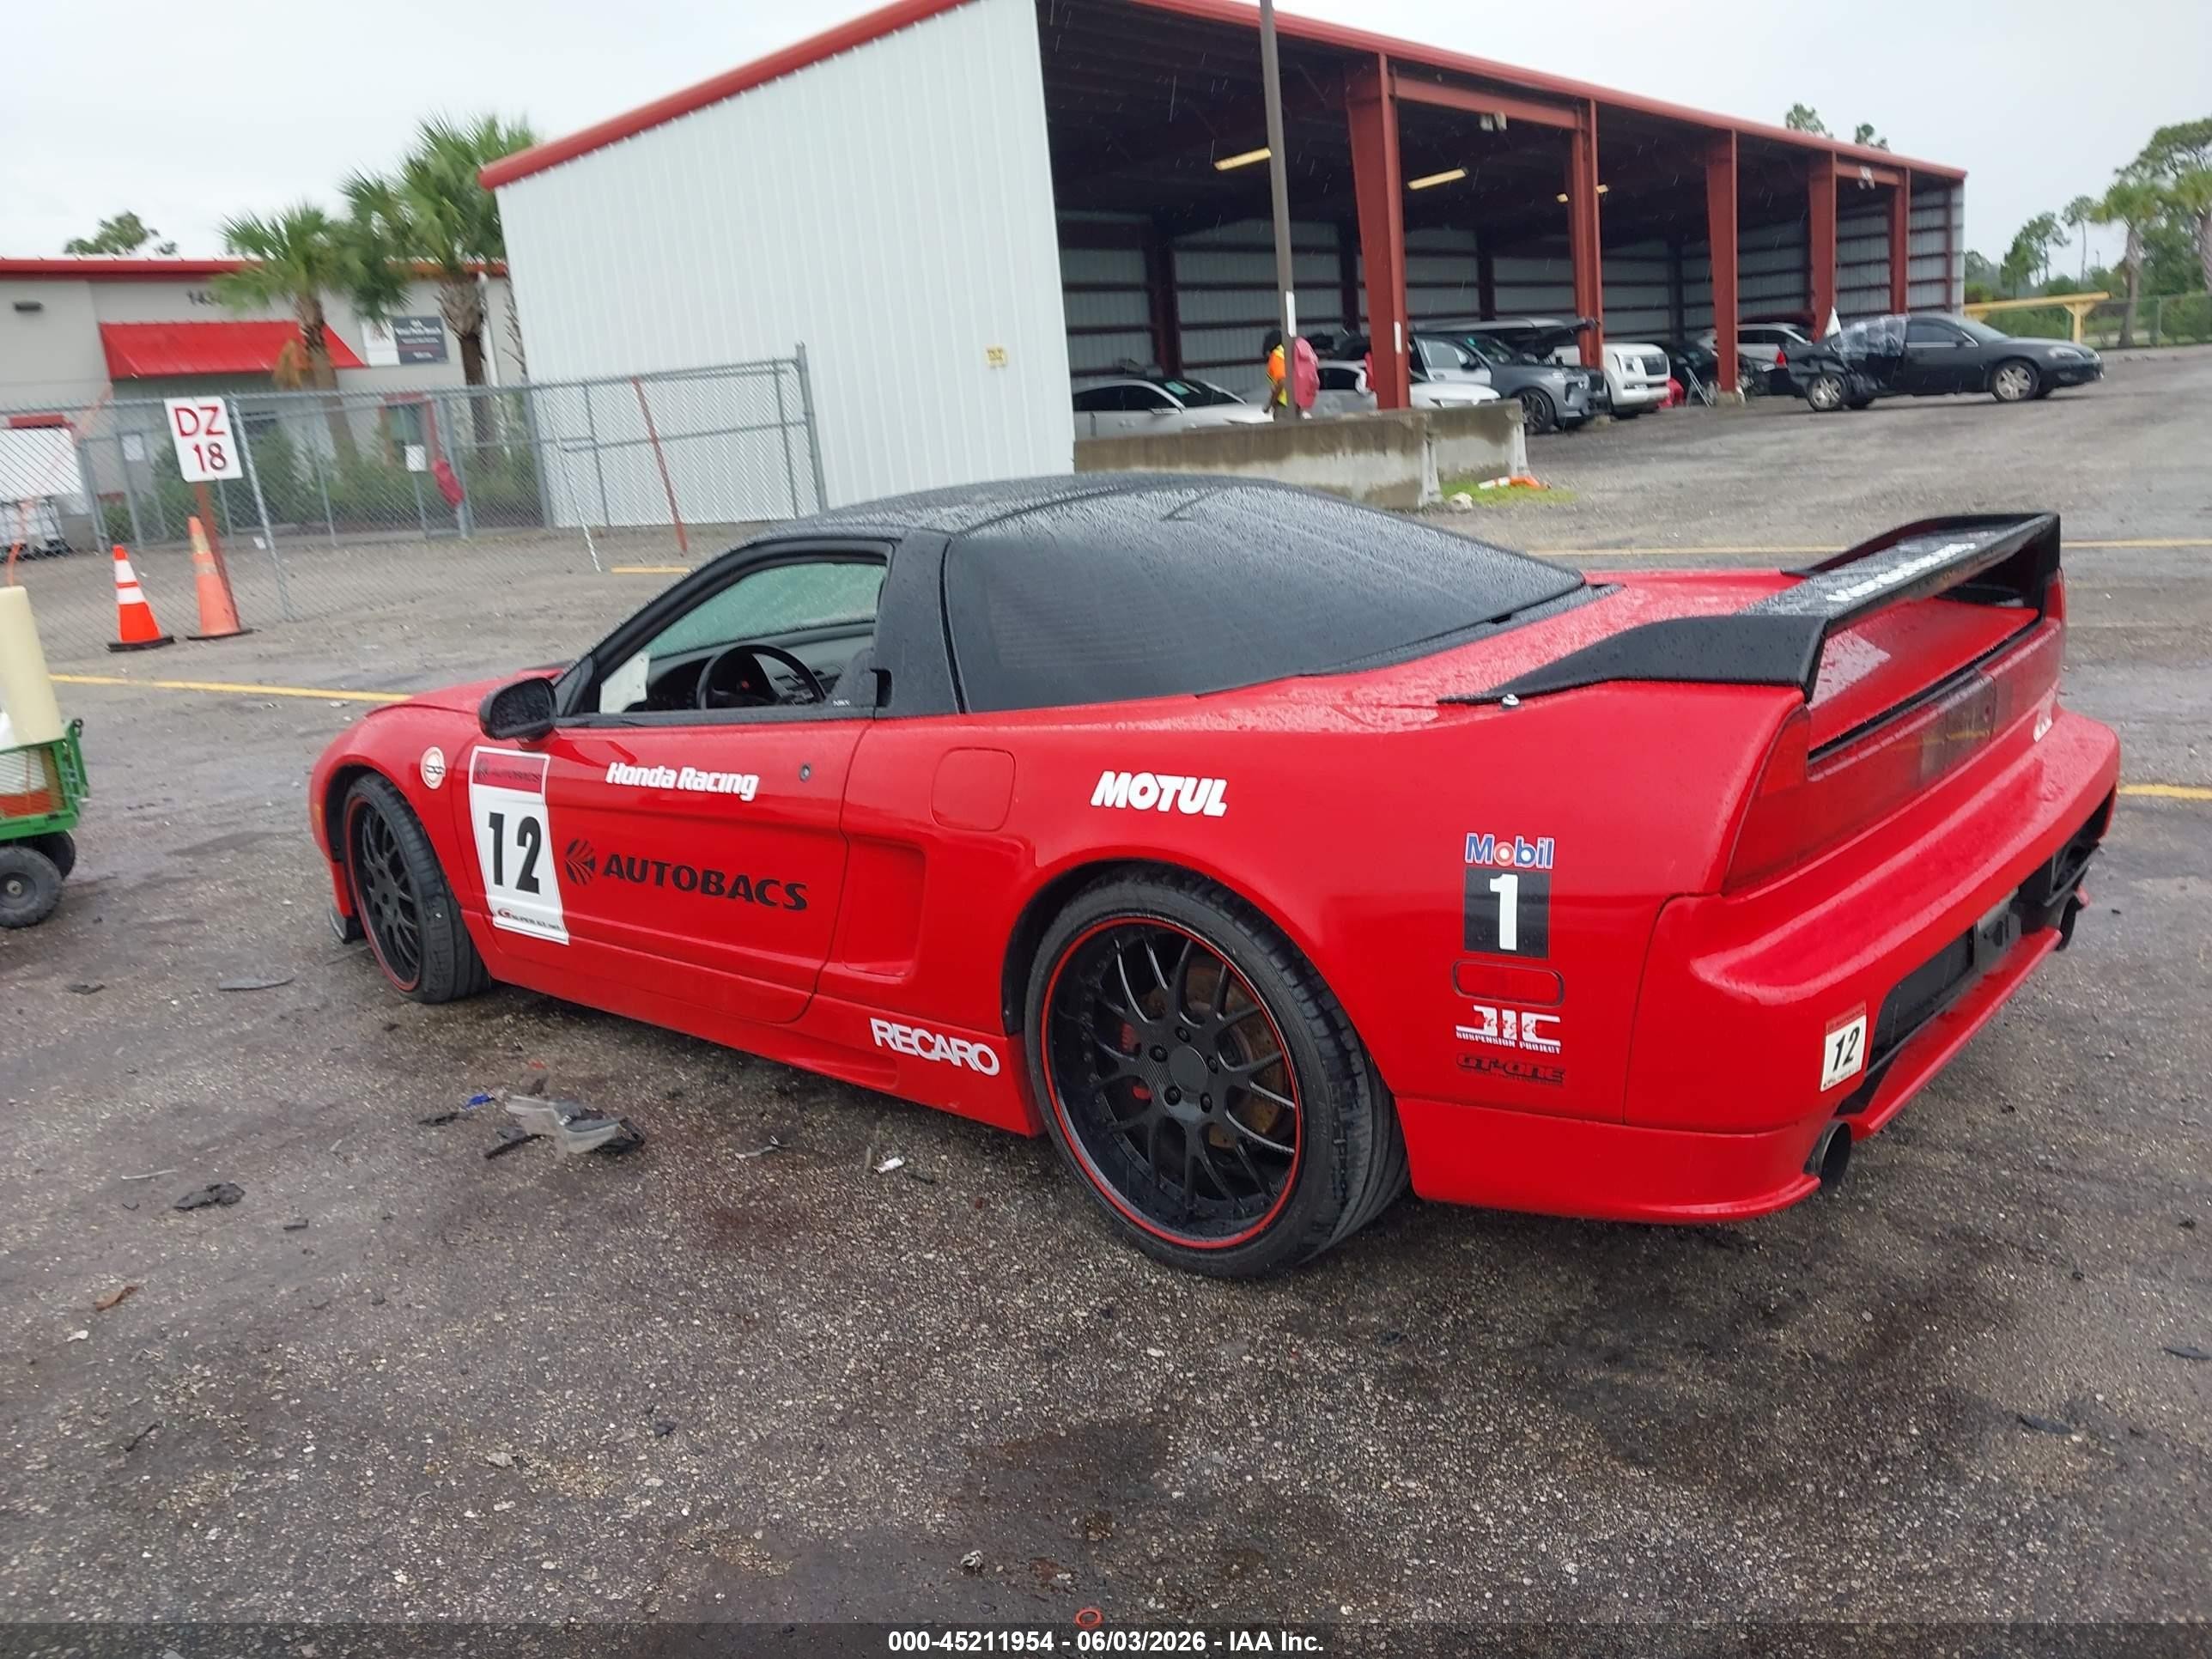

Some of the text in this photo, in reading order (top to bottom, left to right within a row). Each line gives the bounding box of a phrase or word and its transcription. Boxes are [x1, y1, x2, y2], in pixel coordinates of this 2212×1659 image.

[174, 406, 226, 436] DZ
[193, 442, 227, 472] 18
[605, 762, 759, 801] Honda Racing
[1090, 770, 1228, 817] MOTUL
[489, 811, 541, 895] 12
[1465, 832, 1555, 869] Mobil
[603, 854, 808, 911] AUTOBACS
[1490, 872, 1518, 951] 1
[870, 1018, 1000, 1076] RECARO
[1455, 1005, 1561, 1047] JIC
[1833, 1025, 1860, 1073] 12
